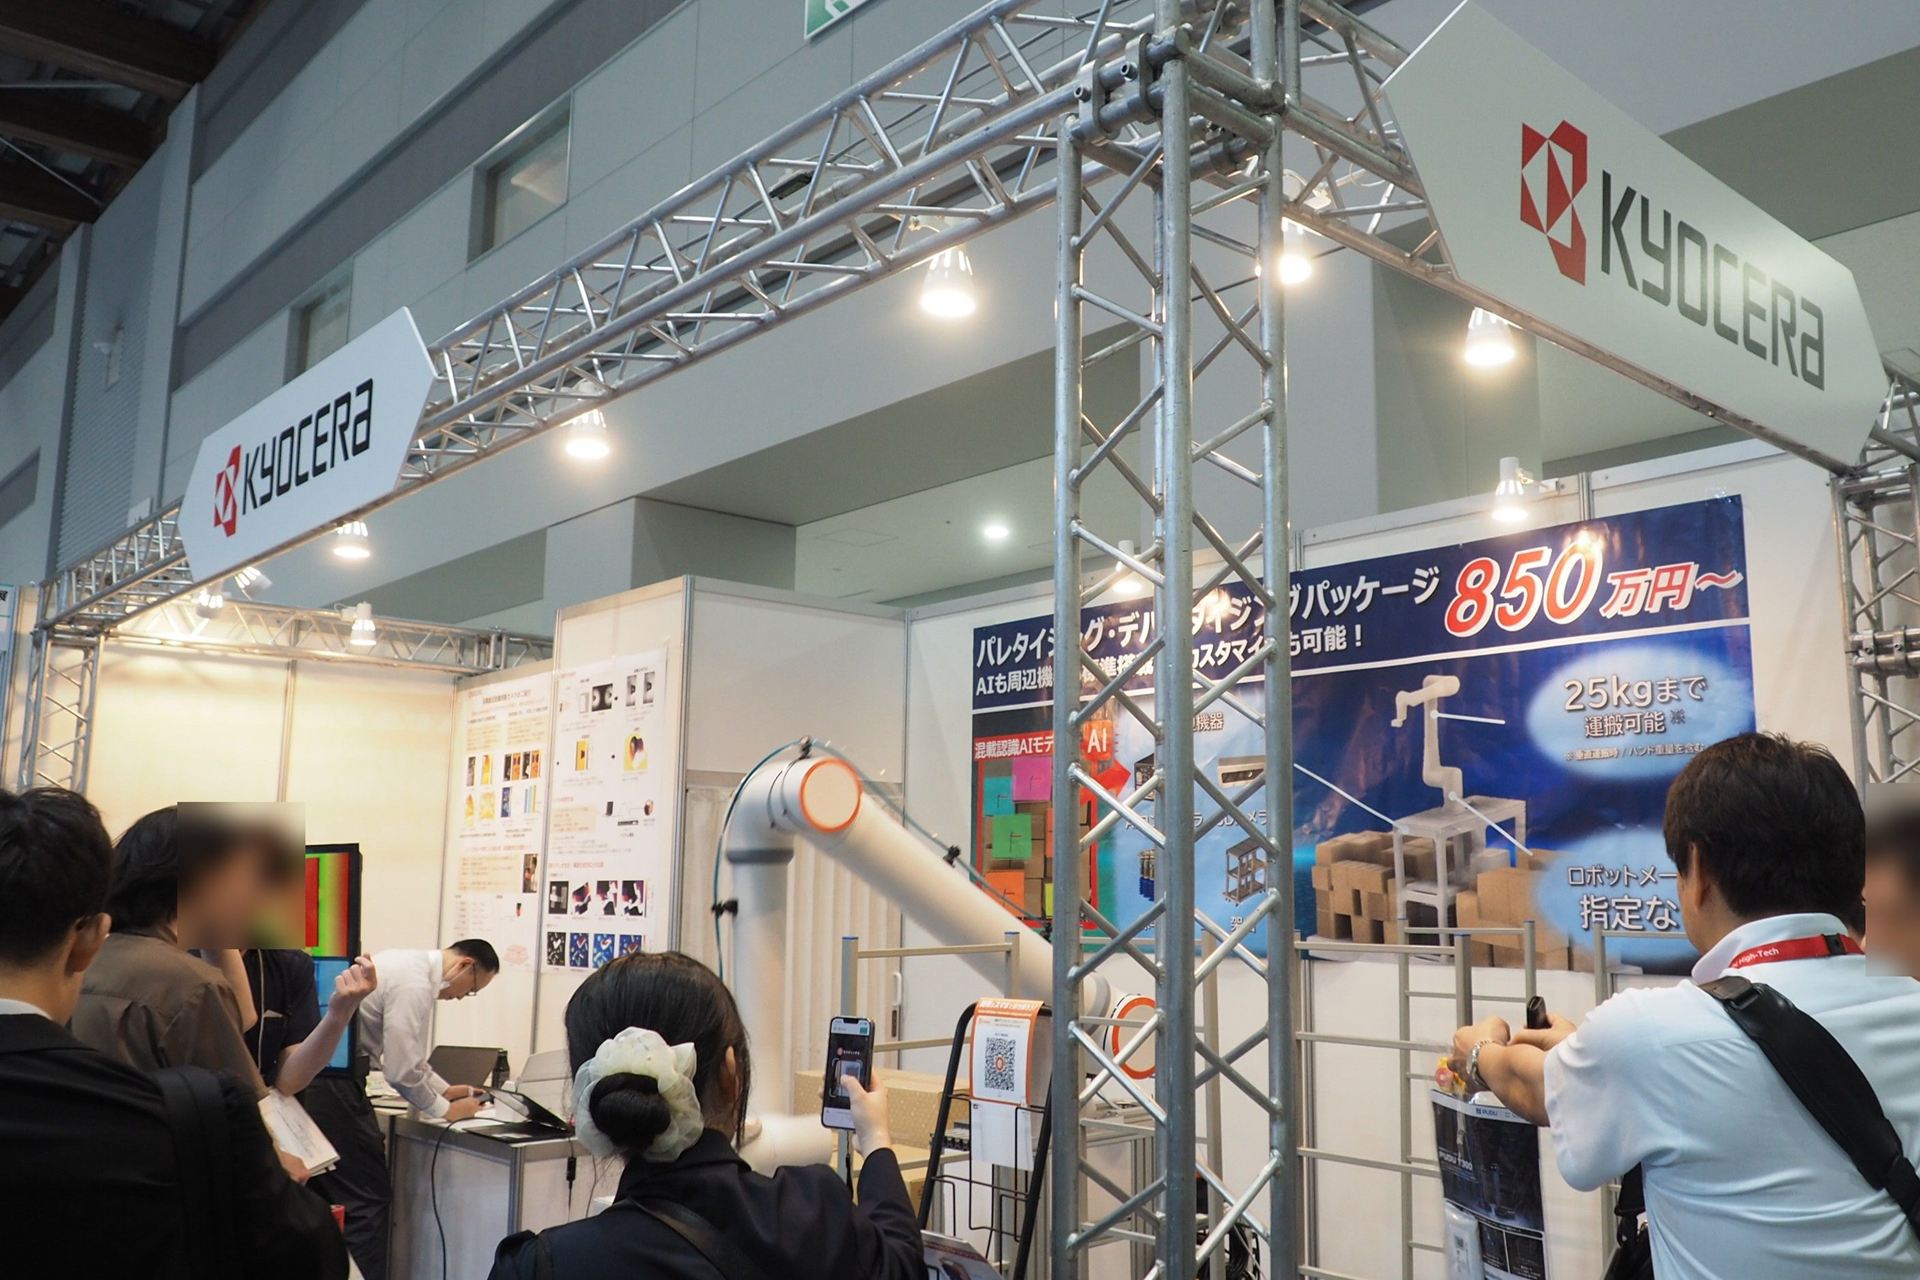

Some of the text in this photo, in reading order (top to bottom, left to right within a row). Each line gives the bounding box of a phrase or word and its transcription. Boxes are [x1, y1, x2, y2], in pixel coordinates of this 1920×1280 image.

[1600, 169, 1826, 392] KYOCERA
[242, 377, 374, 515] KYOCERA
[1564, 675, 1708, 712] 25kgまで
[1087, 728, 1107, 753] AI
[1584, 711, 1666, 737] 運搬可能
[1567, 864, 1677, 886] ロボットメー
[1579, 894, 1680, 931] 指定な
